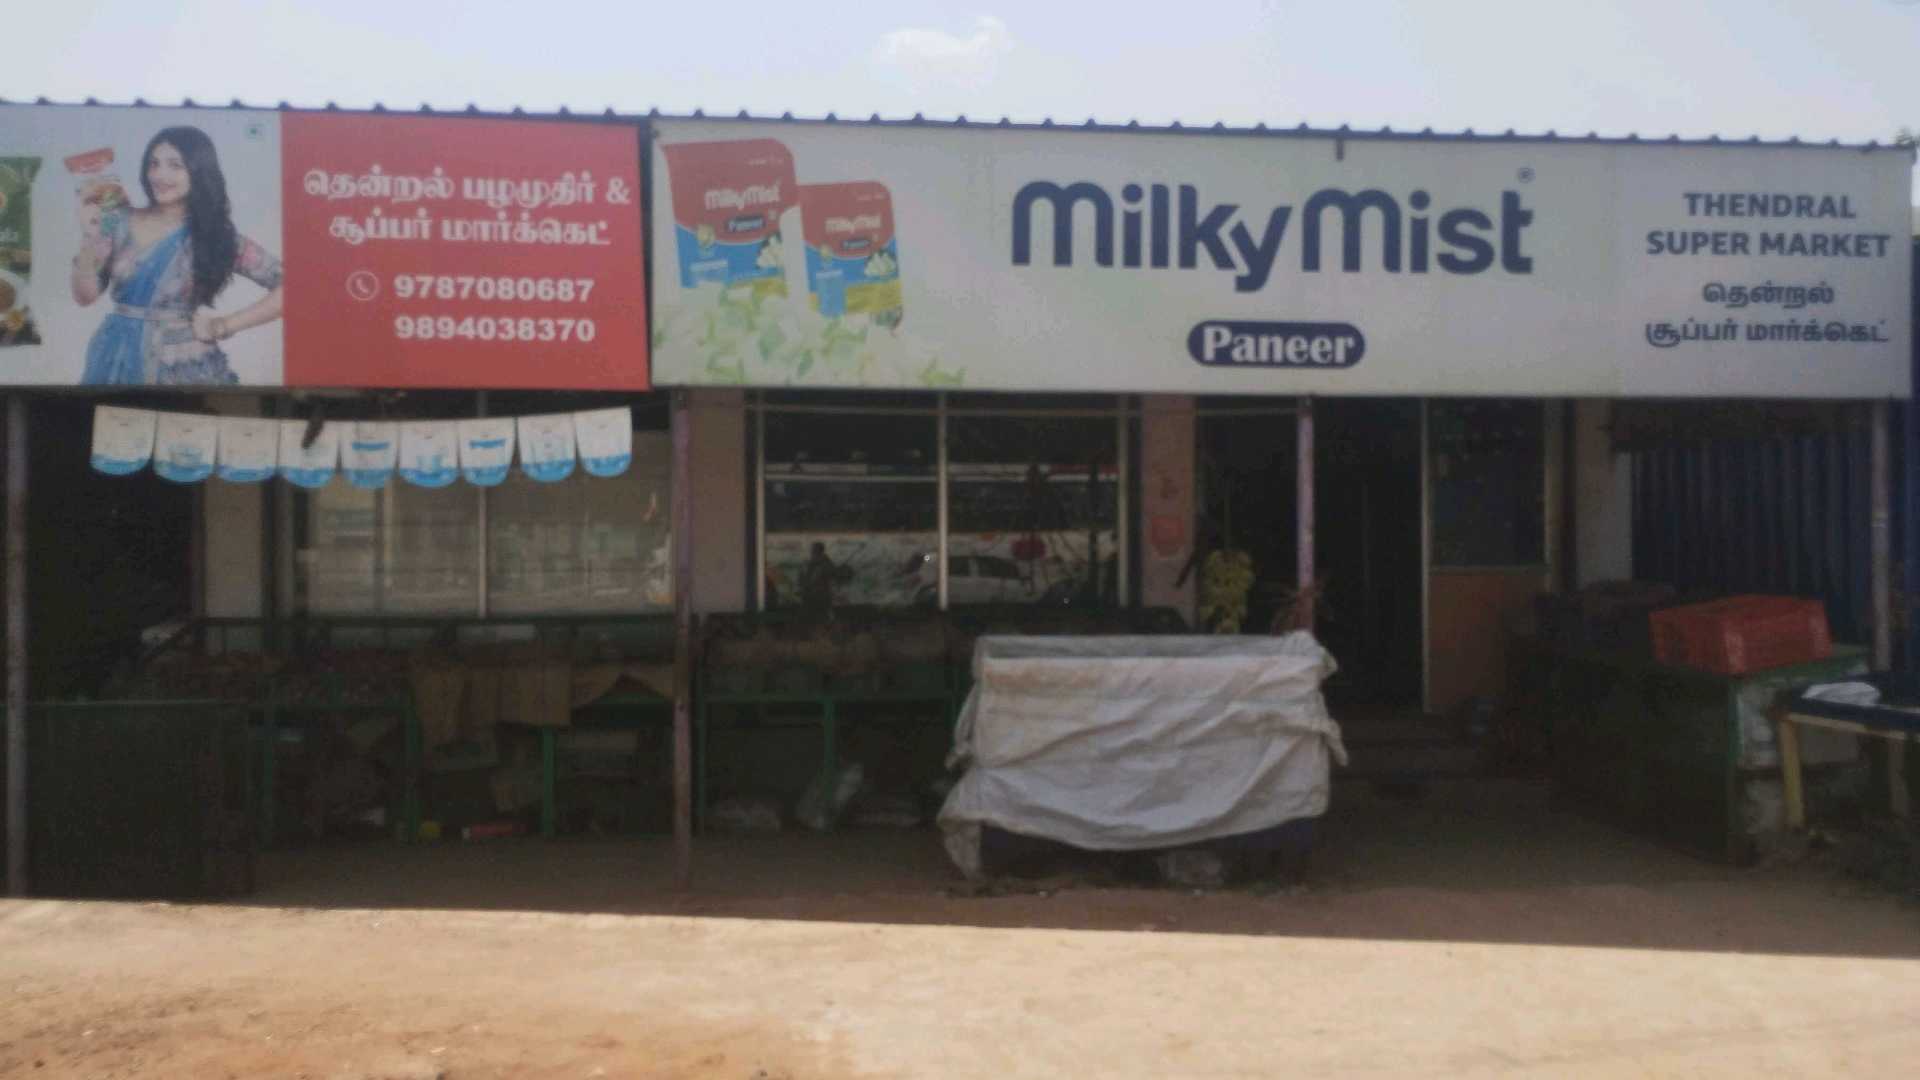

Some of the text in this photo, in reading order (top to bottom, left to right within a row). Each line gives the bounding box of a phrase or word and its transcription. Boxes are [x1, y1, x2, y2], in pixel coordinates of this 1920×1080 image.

[304, 165, 630, 208] தென்றல் பழமுதிர் &
[1684, 193, 1857, 219] THENDRAL
[330, 208, 610, 245] சூப்பர் மார்க்கெட்
[1647, 231, 1891, 258] SUPER MARKET
[395, 275, 595, 302] 9787080687
[1703, 280, 1835, 310] தென்றல்
[395, 316, 596, 342] 9894038370
[1646, 318, 1890, 349] சூப்பர் மார்க்கெட்
[1204, 326, 1355, 364] Paneer
